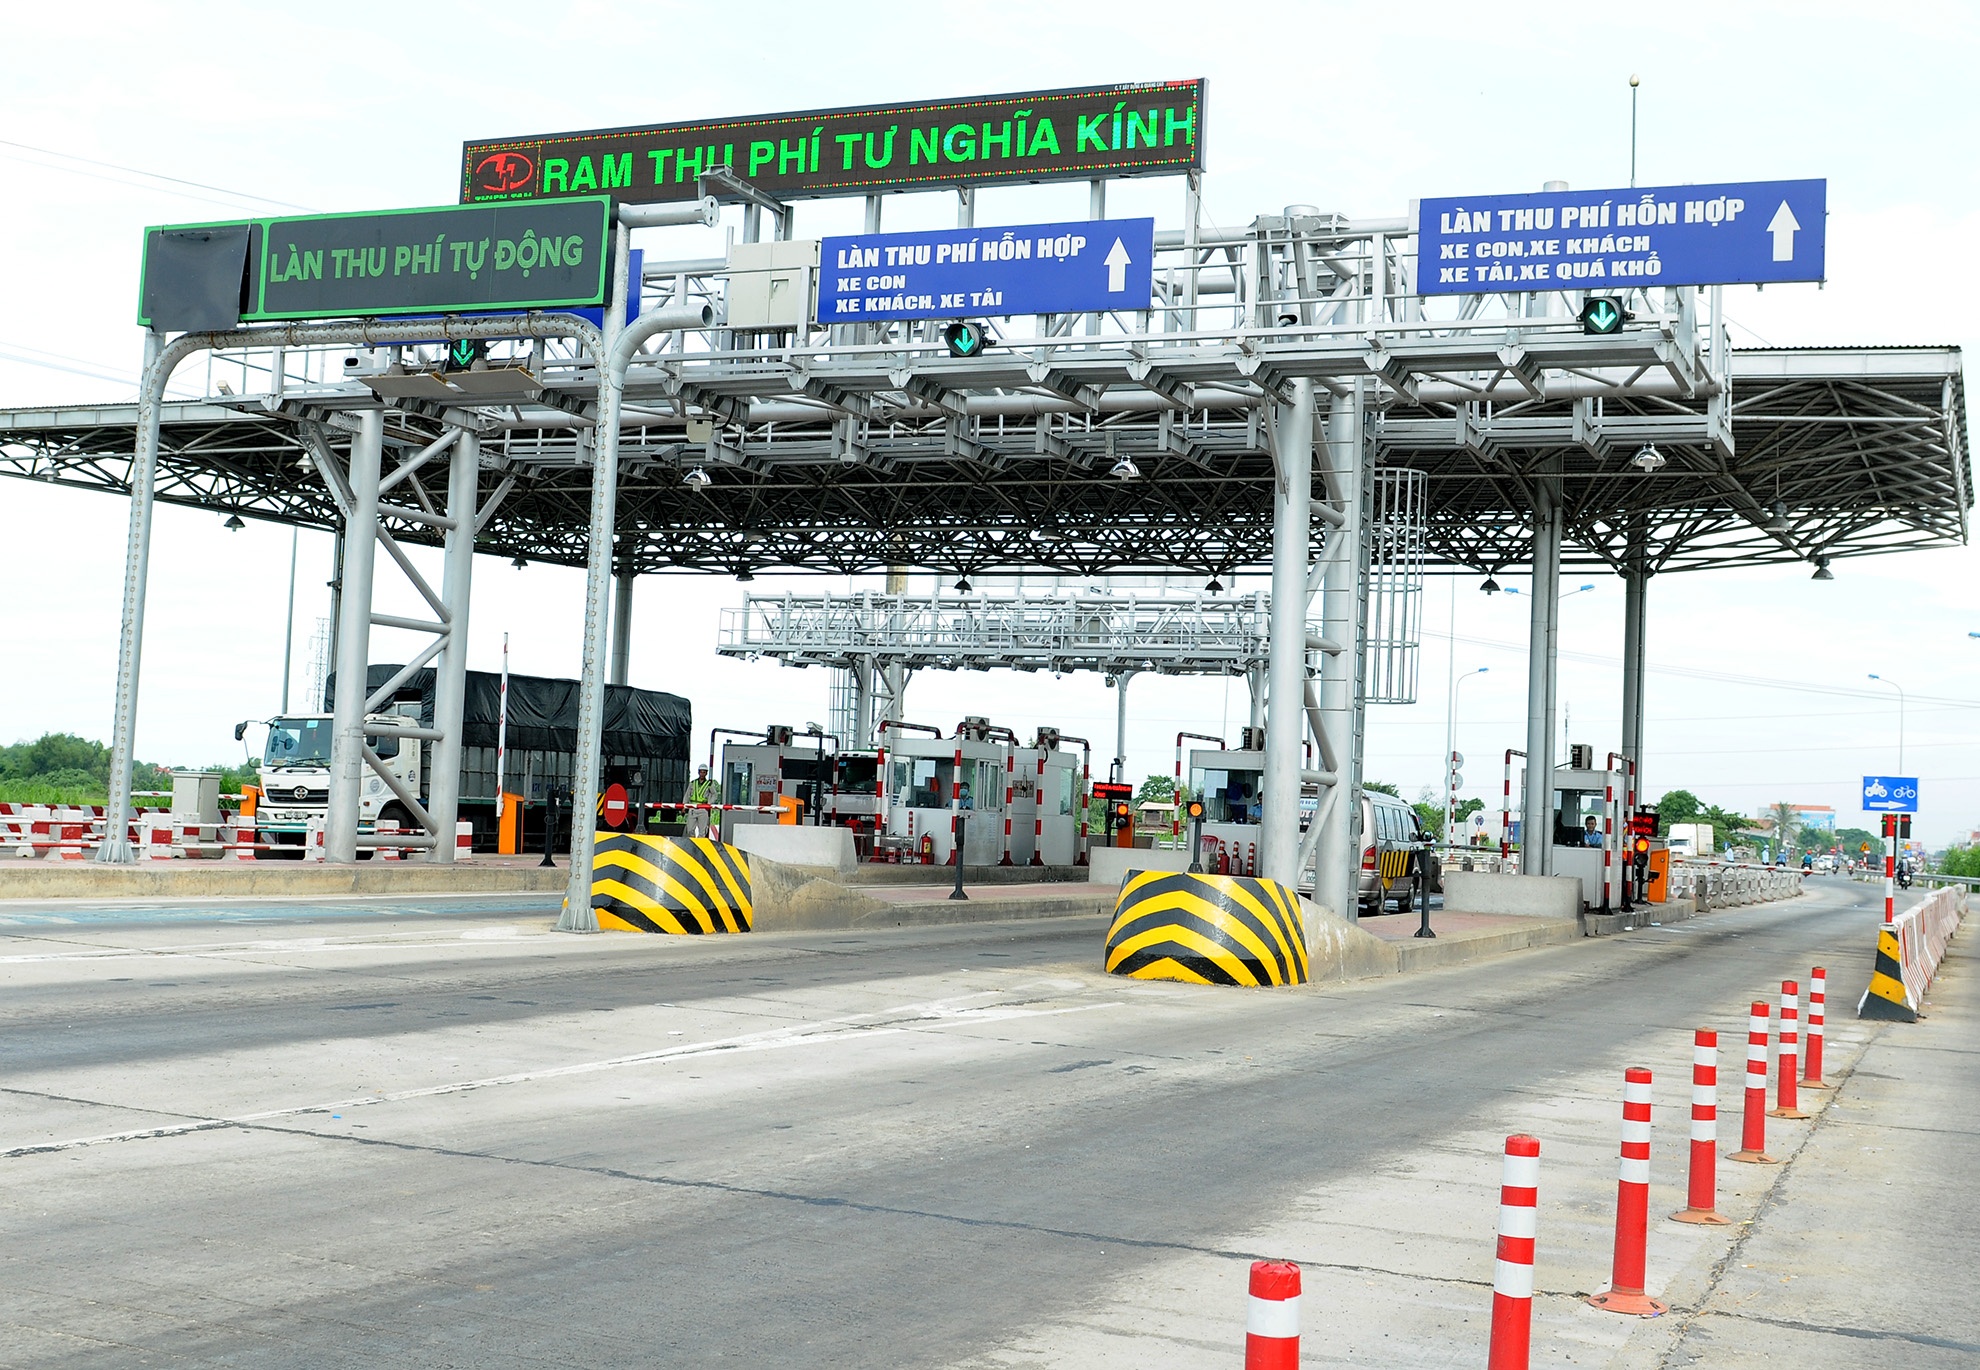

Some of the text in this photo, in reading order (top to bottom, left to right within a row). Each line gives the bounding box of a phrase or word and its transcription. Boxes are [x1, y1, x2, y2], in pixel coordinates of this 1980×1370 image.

[648, 143, 734, 185] THU
[749, 127, 820, 177] PHÍ
[835, 124, 898, 170] TƯ
[909, 109, 1061, 165] NGHĨA
[1076, 101, 1196, 153] KÍNH
[1440, 194, 1745, 234] LÀN THU PHÍ HỖN HỢP
[270, 229, 584, 283] LÀN THU PHÍ TỰ ĐỘNG
[837, 232, 1087, 269] LÀN THU PHÍ HỖN HỢP
[1439, 243, 1470, 260] XE
[1566, 234, 1650, 254] KHÁCH
[836, 275, 906, 292] XE CON
[1439, 267, 1469, 283] XE
[1556, 258, 1605, 280] QUÁ
[1612, 250, 1662, 276] KHỔ
[836, 287, 1003, 313] XE KHÁCH, XE TẢI
